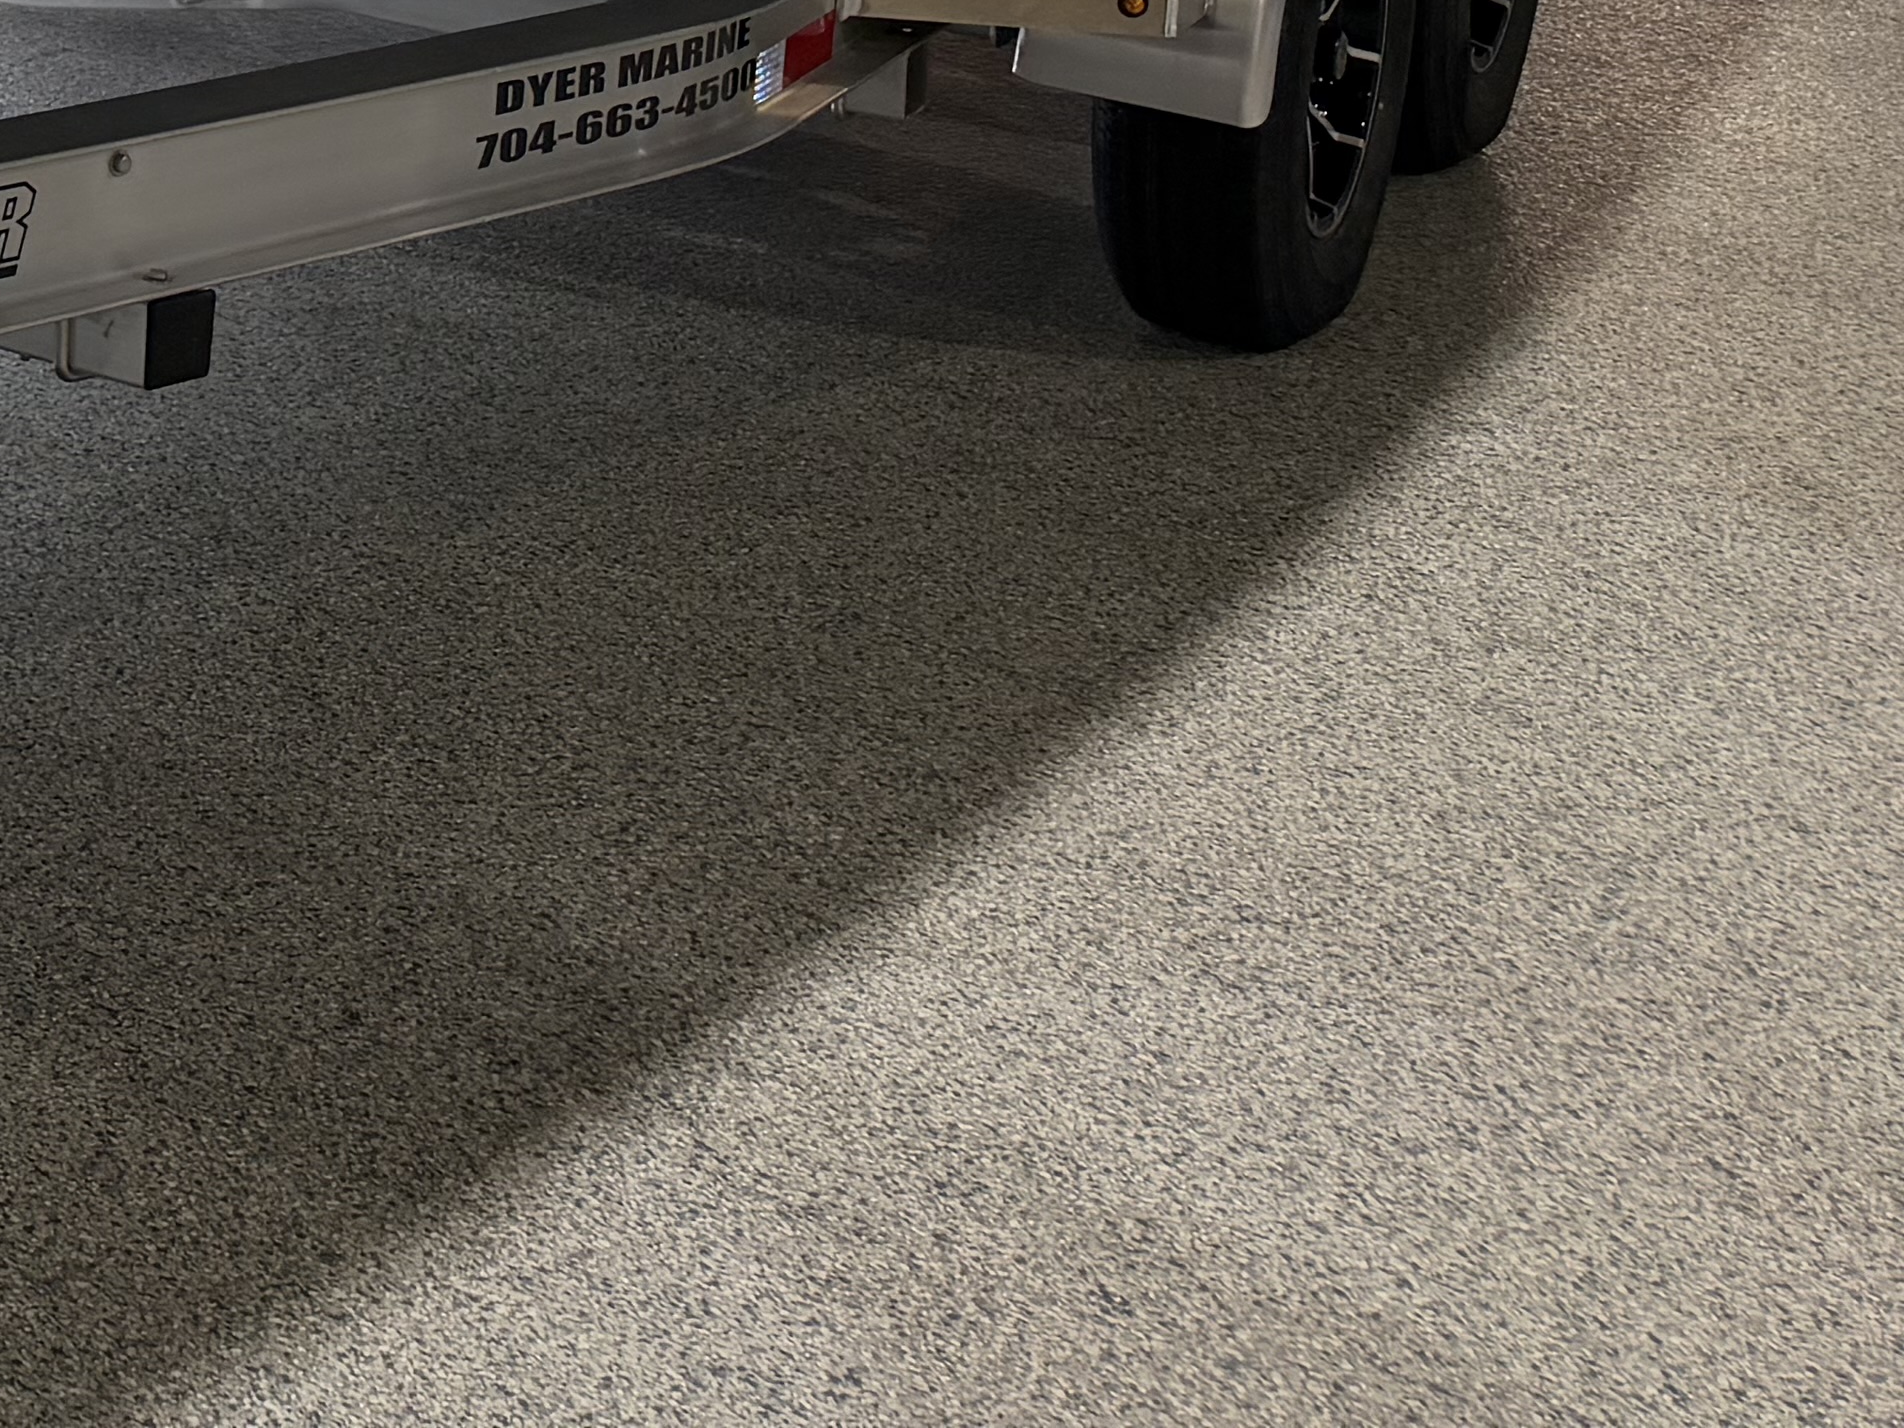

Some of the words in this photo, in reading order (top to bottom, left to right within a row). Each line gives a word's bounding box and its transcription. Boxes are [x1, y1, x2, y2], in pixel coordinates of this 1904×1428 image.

[476, 57, 757, 170] 704-663-4500
[495, 61, 606, 115] DYER
[618, 17, 751, 88] MARINE
